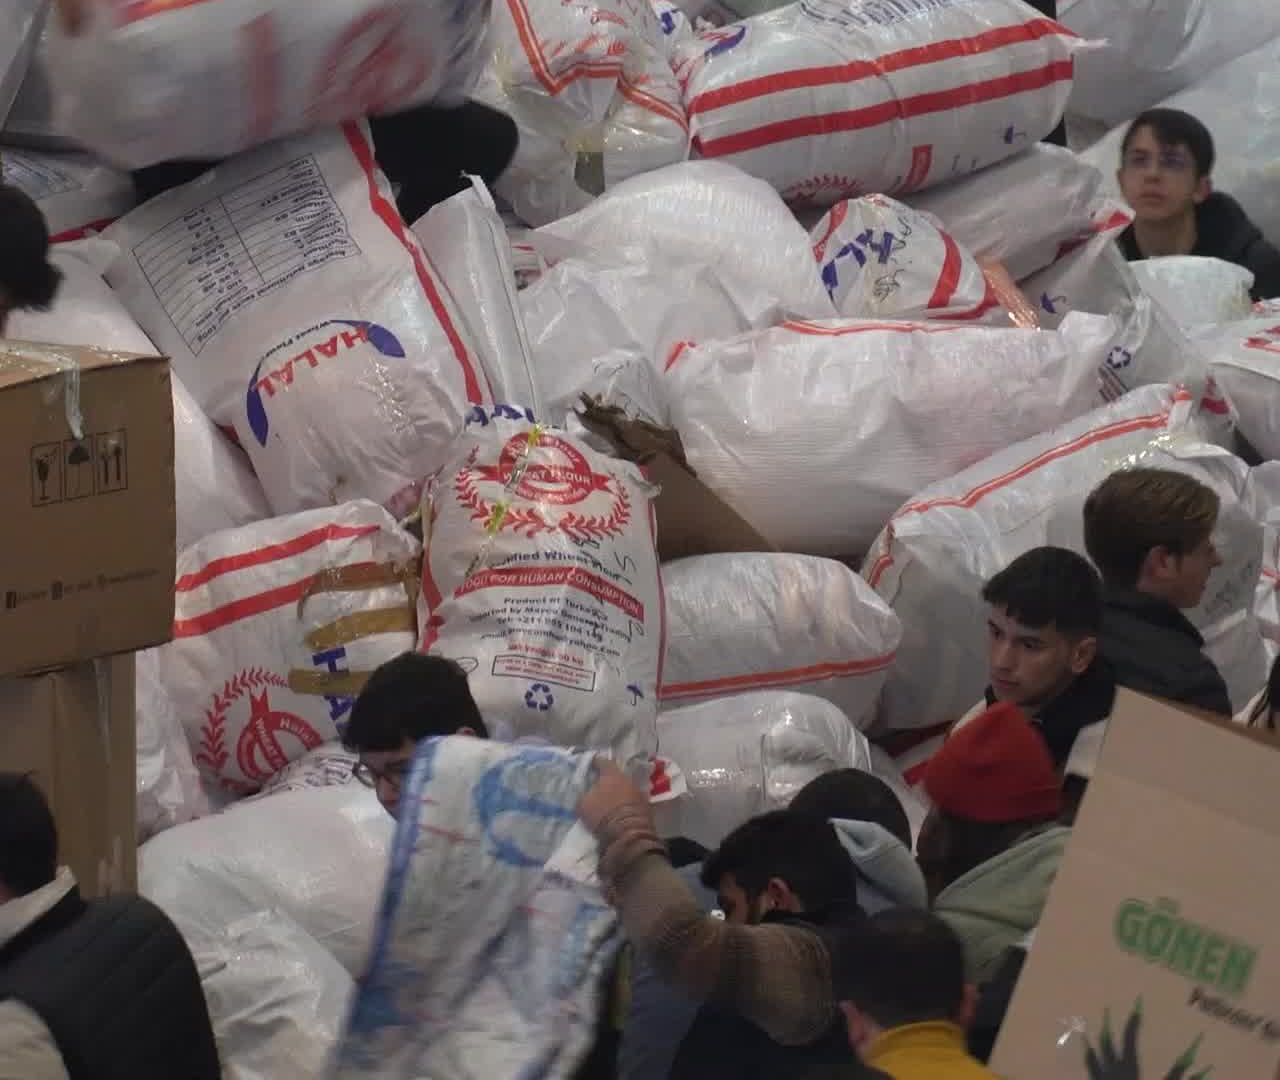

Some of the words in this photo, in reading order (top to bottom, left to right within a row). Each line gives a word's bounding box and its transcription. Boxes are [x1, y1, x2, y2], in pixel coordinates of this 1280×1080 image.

[256, 327, 369, 398] HALAL
[519, 572, 564, 584] HUMAN
[1113, 896, 1265, 995] GÖNEN
